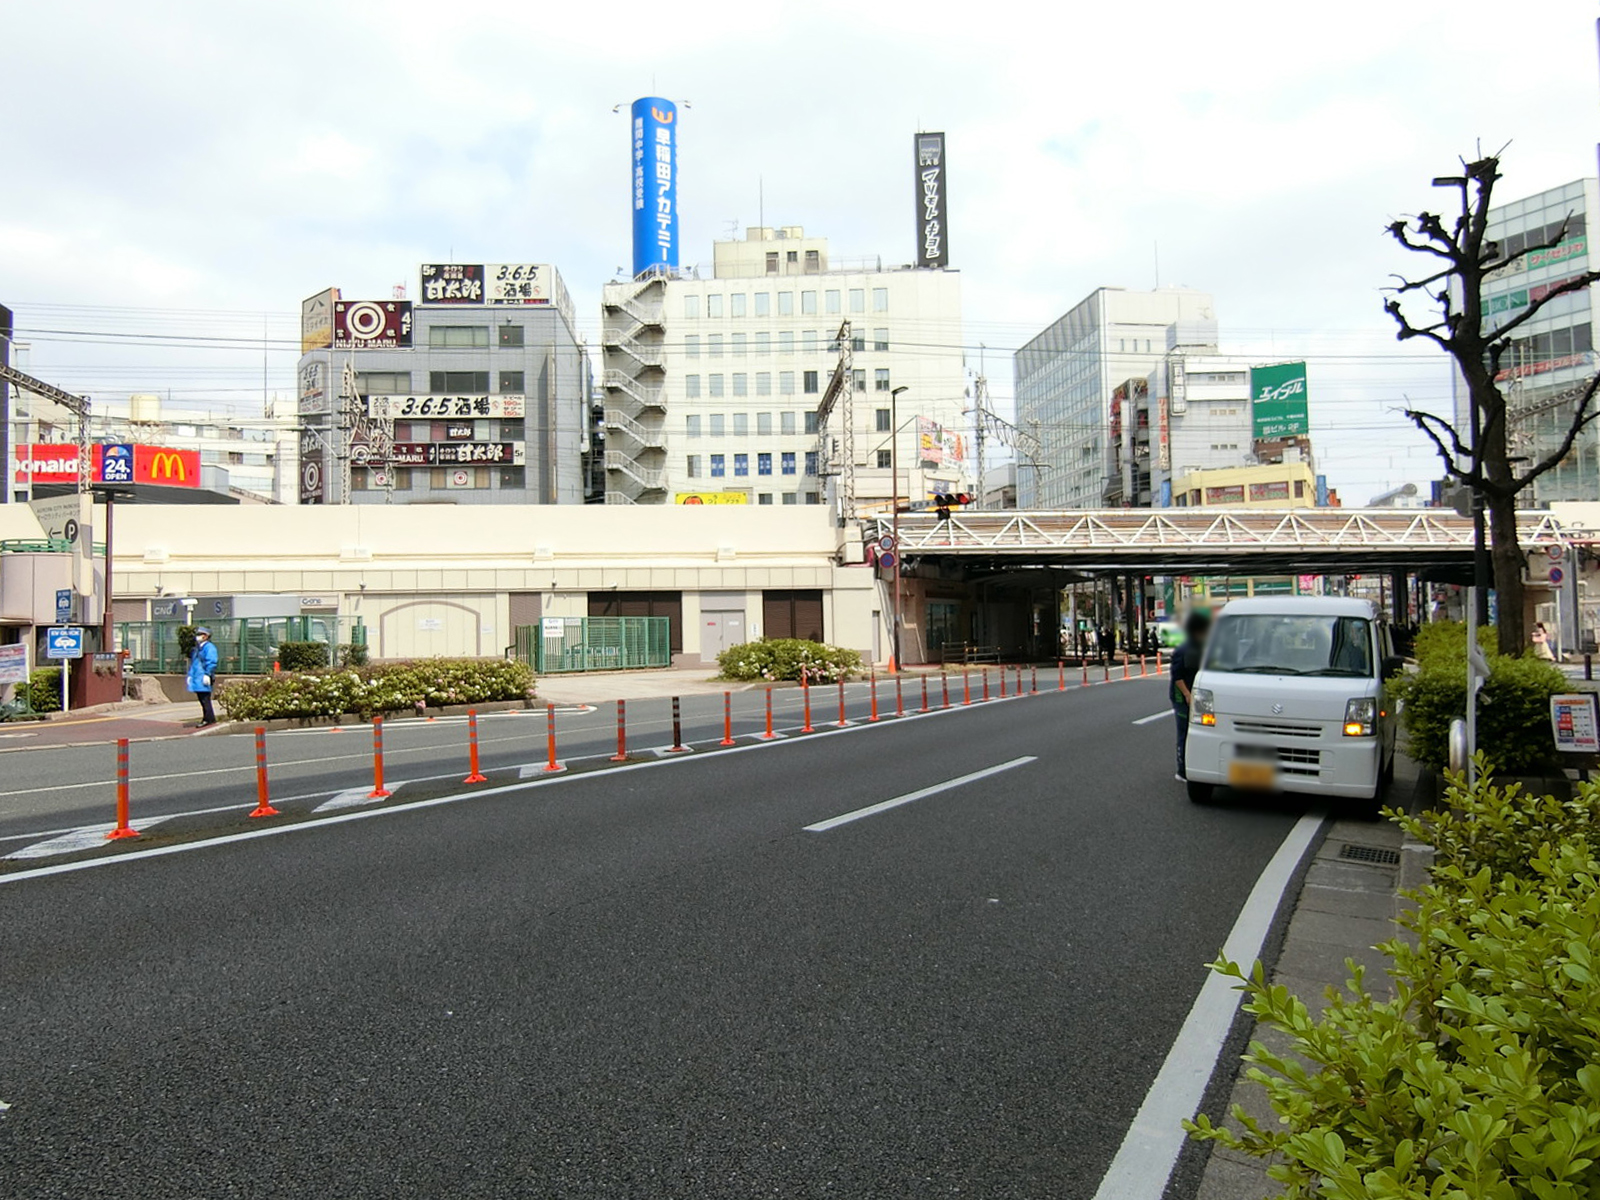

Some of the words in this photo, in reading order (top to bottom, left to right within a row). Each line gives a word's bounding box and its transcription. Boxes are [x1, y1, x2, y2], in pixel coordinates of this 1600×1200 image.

[655, 127, 672, 262] 早稲田アカデミー
[922, 168, 941, 259] マツモトキヨシ
[422, 265, 437, 276] 5F
[425, 278, 482, 300] 甘太郎
[504, 282, 532, 298] 酒場
[1254, 377, 1305, 403] エイブル
[457, 443, 504, 462] 甘太郎
[68, 524, 76, 542] P
